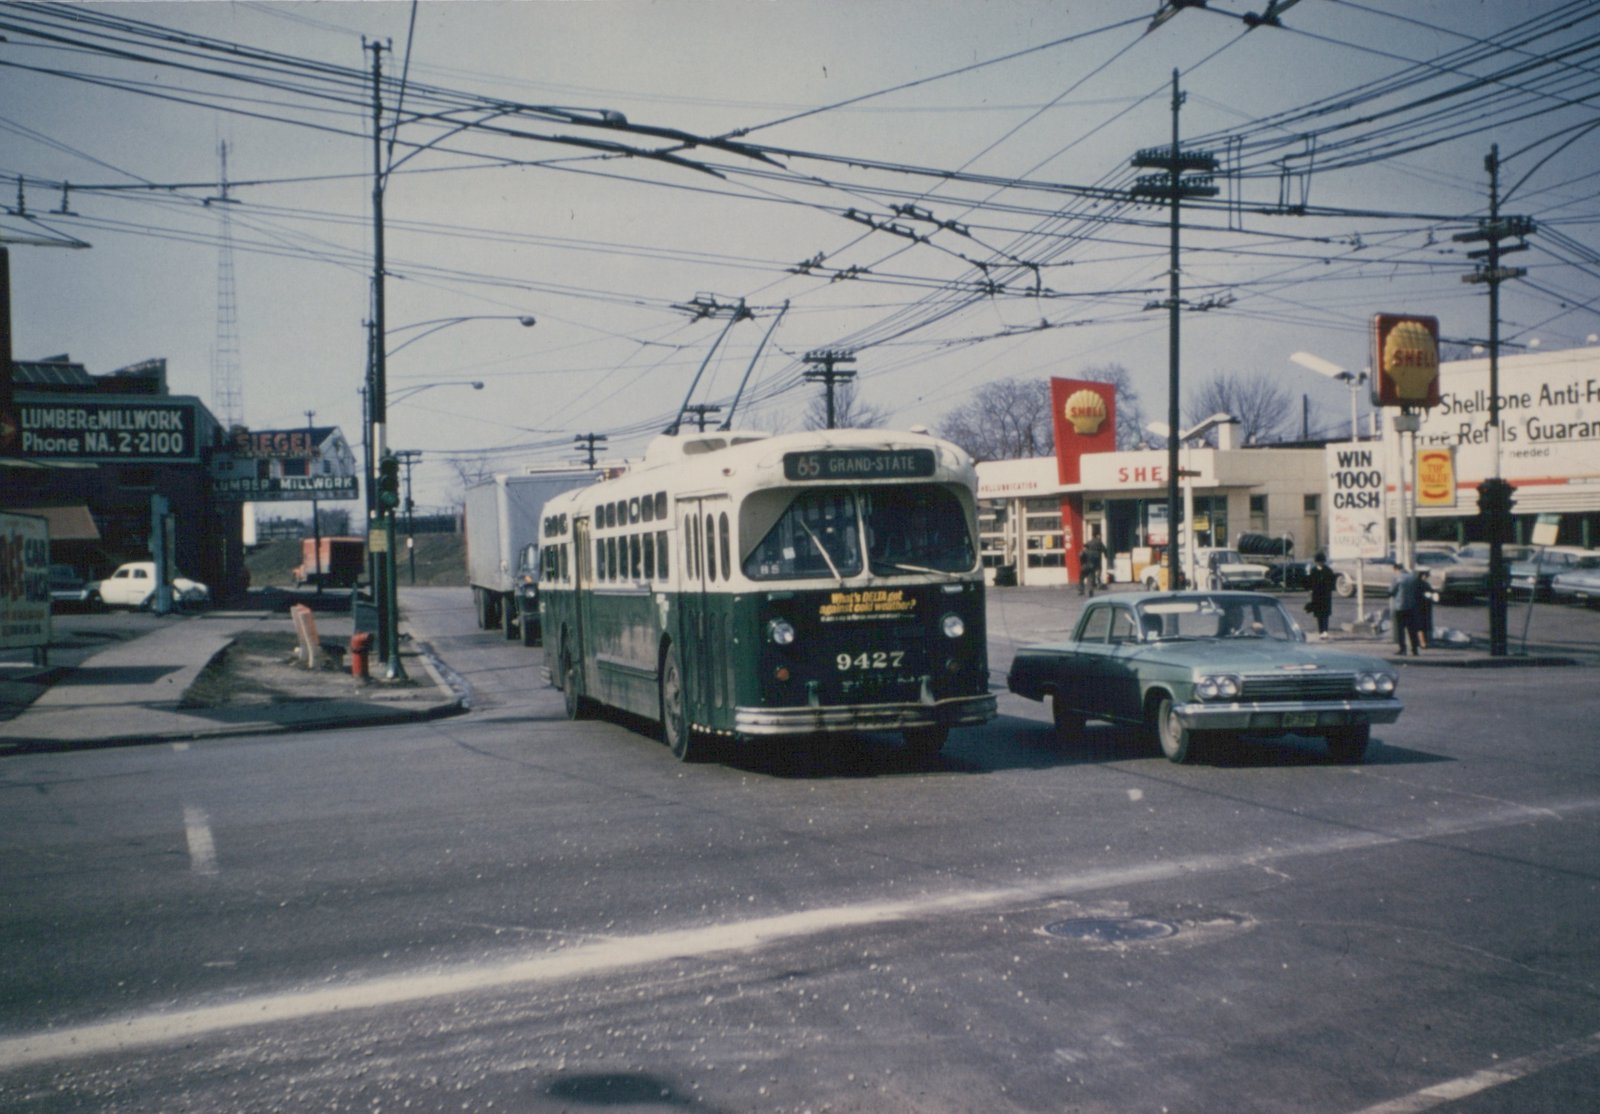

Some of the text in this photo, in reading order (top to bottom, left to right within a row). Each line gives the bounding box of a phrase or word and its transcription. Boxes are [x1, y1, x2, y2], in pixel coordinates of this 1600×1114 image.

[1071, 406, 1104, 417] SHELL
[22, 432, 79, 452] Phone
[84, 433, 115, 452] NA.
[234, 431, 313, 452] SIEGEL
[1460, 420, 1517, 445] Refls
[1337, 450, 1372, 468] WIN
[280, 476, 352, 490] MILLWORK
[1118, 465, 1190, 482] SHE
[1333, 491, 1380, 510] CASH
[836, 651, 905, 671] 9427
